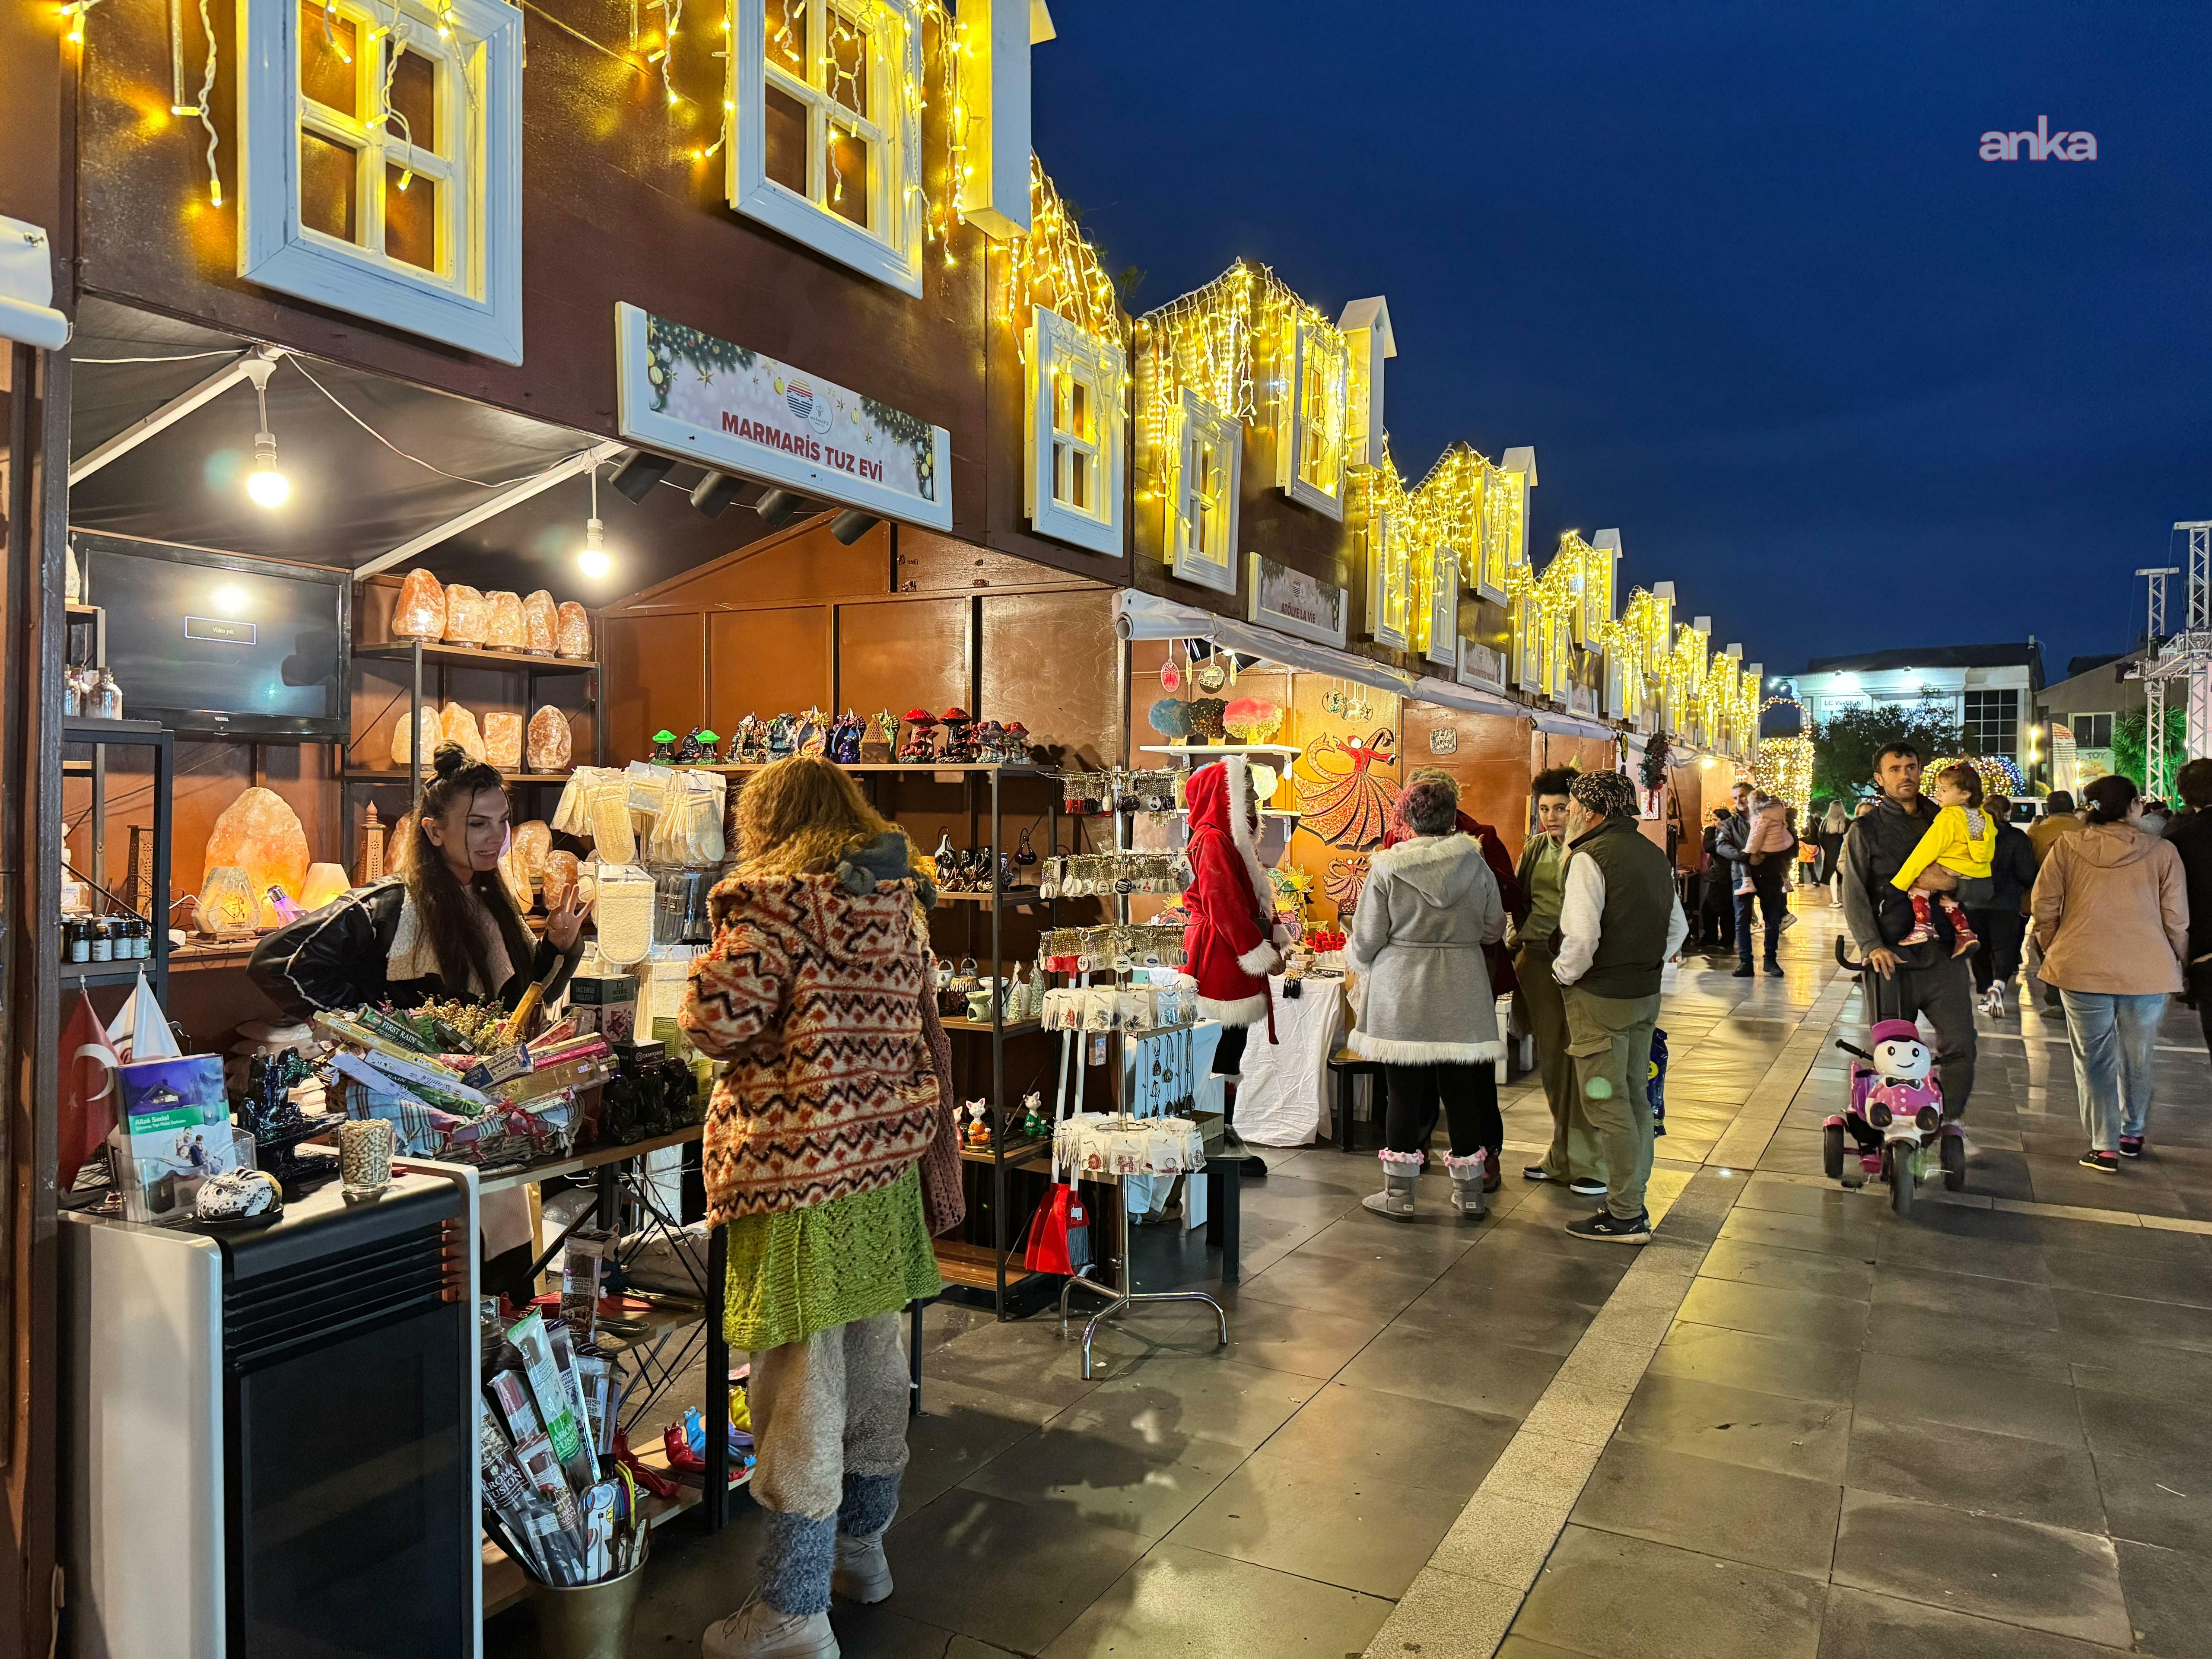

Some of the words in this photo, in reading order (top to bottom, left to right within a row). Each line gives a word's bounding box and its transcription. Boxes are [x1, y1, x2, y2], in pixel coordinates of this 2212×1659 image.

[722, 411, 820, 461] MARMARİS
[824, 446, 855, 473] TUZ
[859, 458, 883, 482] EVİ
[1281, 602, 1300, 618] ATÖLYE
[1300, 609, 1307, 621] LA
[1307, 610, 1316, 623] VİE
[382, 1021, 400, 1035] FIRST
[400, 1030, 417, 1043] RAIN
[540, 1056, 560, 1065] YLANG
[554, 1424, 573, 1444] AROM
[560, 1511, 576, 1524] SION
